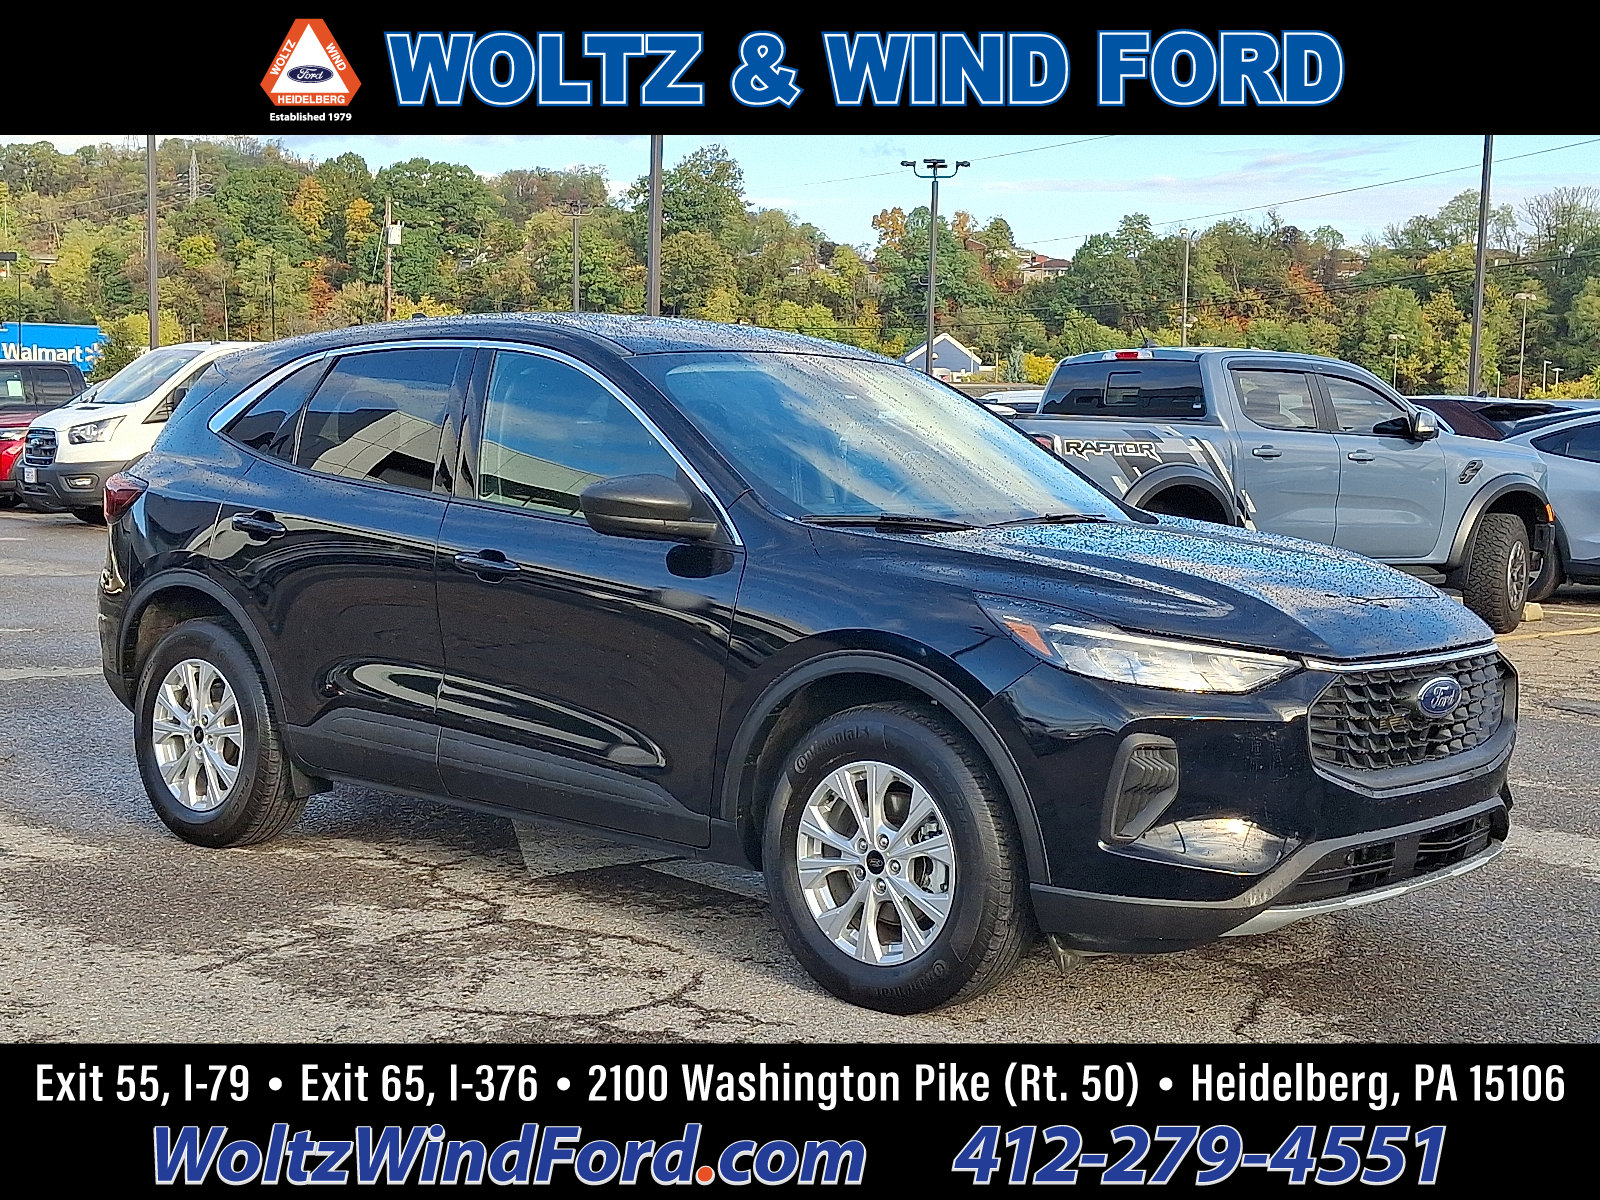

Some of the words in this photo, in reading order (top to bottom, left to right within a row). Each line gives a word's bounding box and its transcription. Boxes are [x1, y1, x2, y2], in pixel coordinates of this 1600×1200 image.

[1, 342, 83, 362] Walmart
[1064, 440, 1162, 463] RAPTOR
[1430, 685, 1456, 709] Ford
